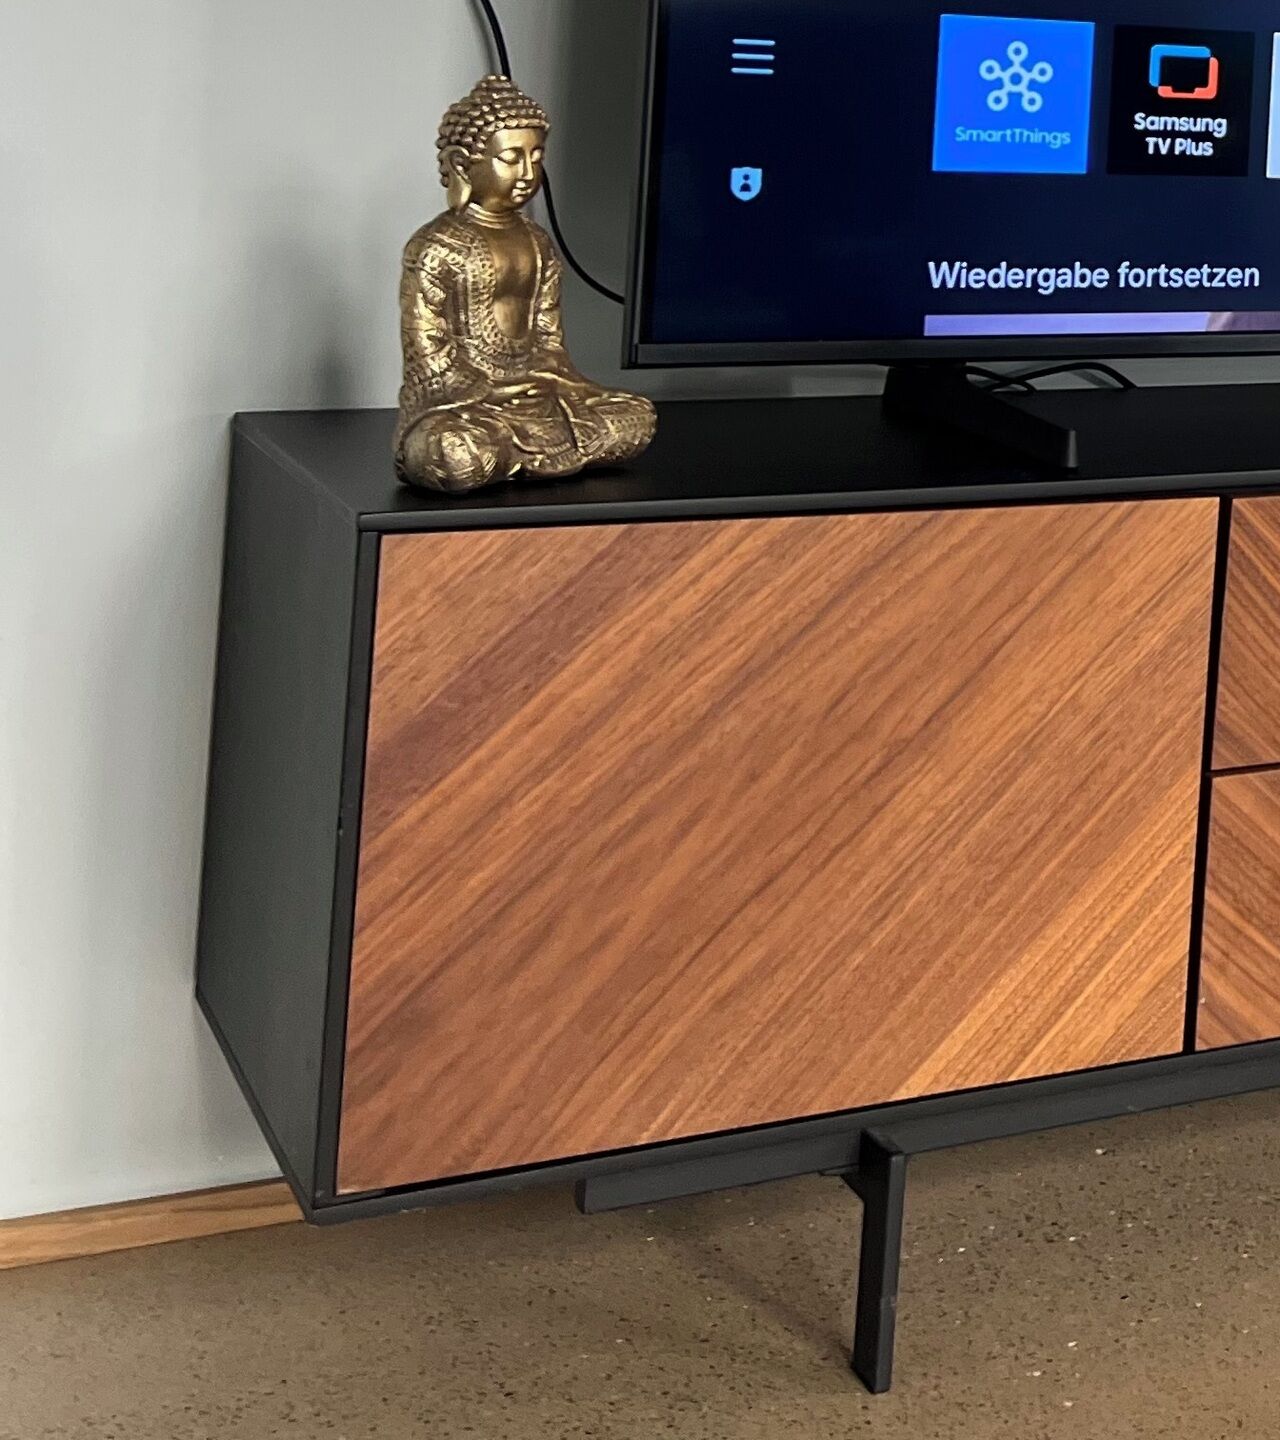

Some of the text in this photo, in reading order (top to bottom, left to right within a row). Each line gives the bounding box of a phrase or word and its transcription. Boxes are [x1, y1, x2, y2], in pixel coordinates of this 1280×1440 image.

[954, 125, 1072, 149] SmartThings
[1134, 112, 1228, 139] Samsung
[1145, 136, 1214, 158] TV Plus
[928, 260, 1260, 294] Wiedergabe fortsetzen
